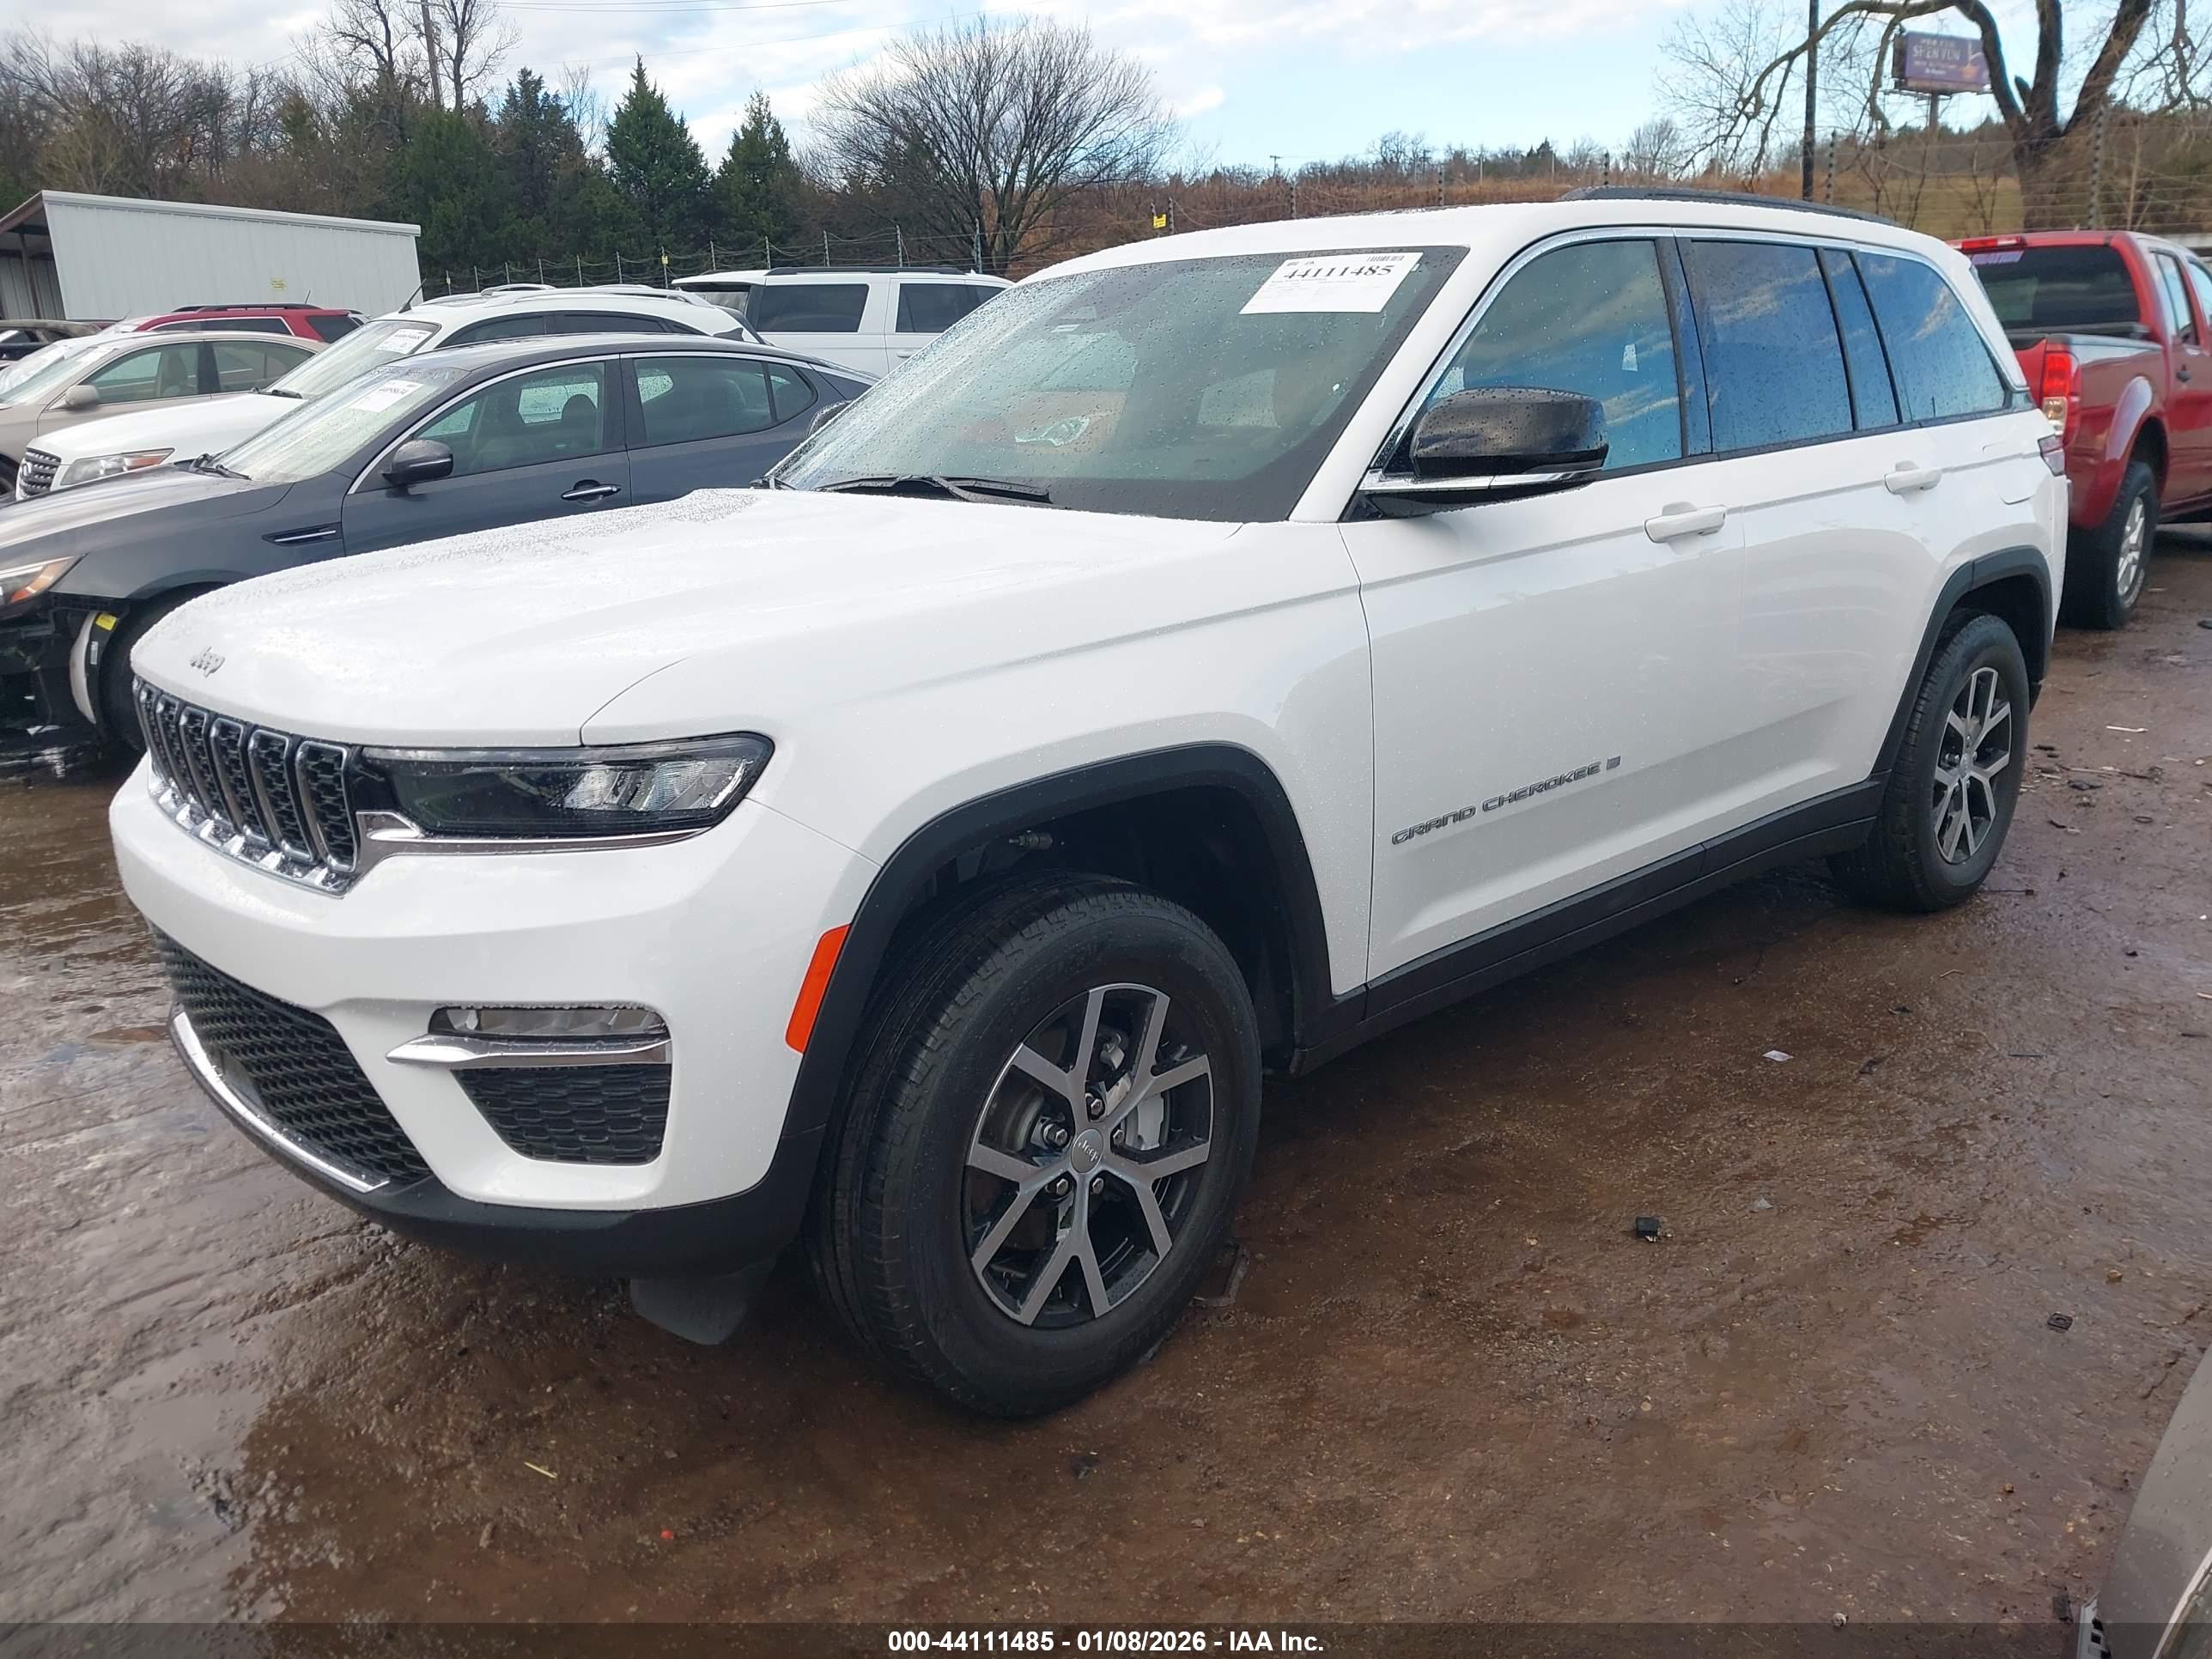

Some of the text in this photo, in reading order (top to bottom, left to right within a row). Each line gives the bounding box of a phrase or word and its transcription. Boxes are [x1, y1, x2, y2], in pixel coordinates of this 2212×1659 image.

[1284, 264, 1395, 279] 44111485
[190, 646, 226, 678] Jeep
[1391, 761, 1601, 845] GRAND CHEROKEE
[1077, 1139, 1099, 1162] Jeep
